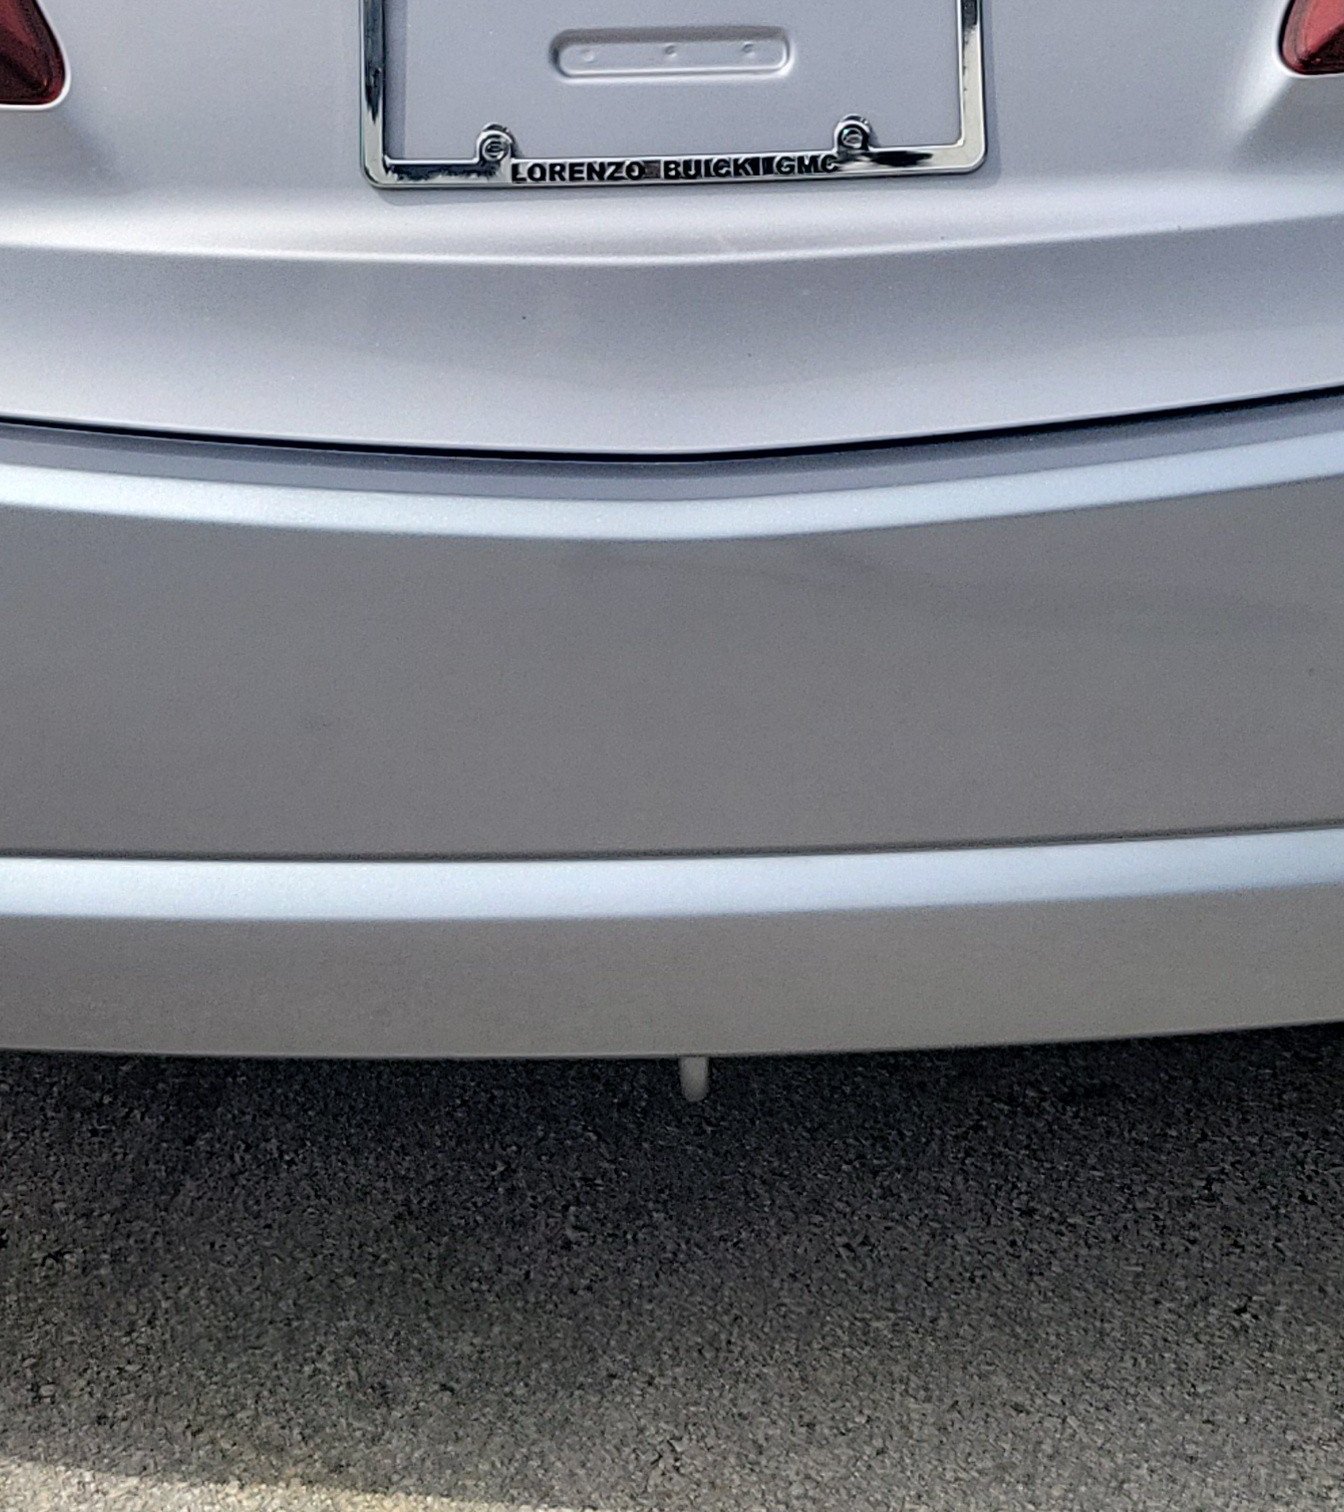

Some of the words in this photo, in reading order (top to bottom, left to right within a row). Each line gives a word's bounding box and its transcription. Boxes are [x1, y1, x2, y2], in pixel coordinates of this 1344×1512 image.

[511, 160, 646, 184] LORENZO
[662, 156, 753, 180] BUICK
[774, 153, 841, 175] GMC
